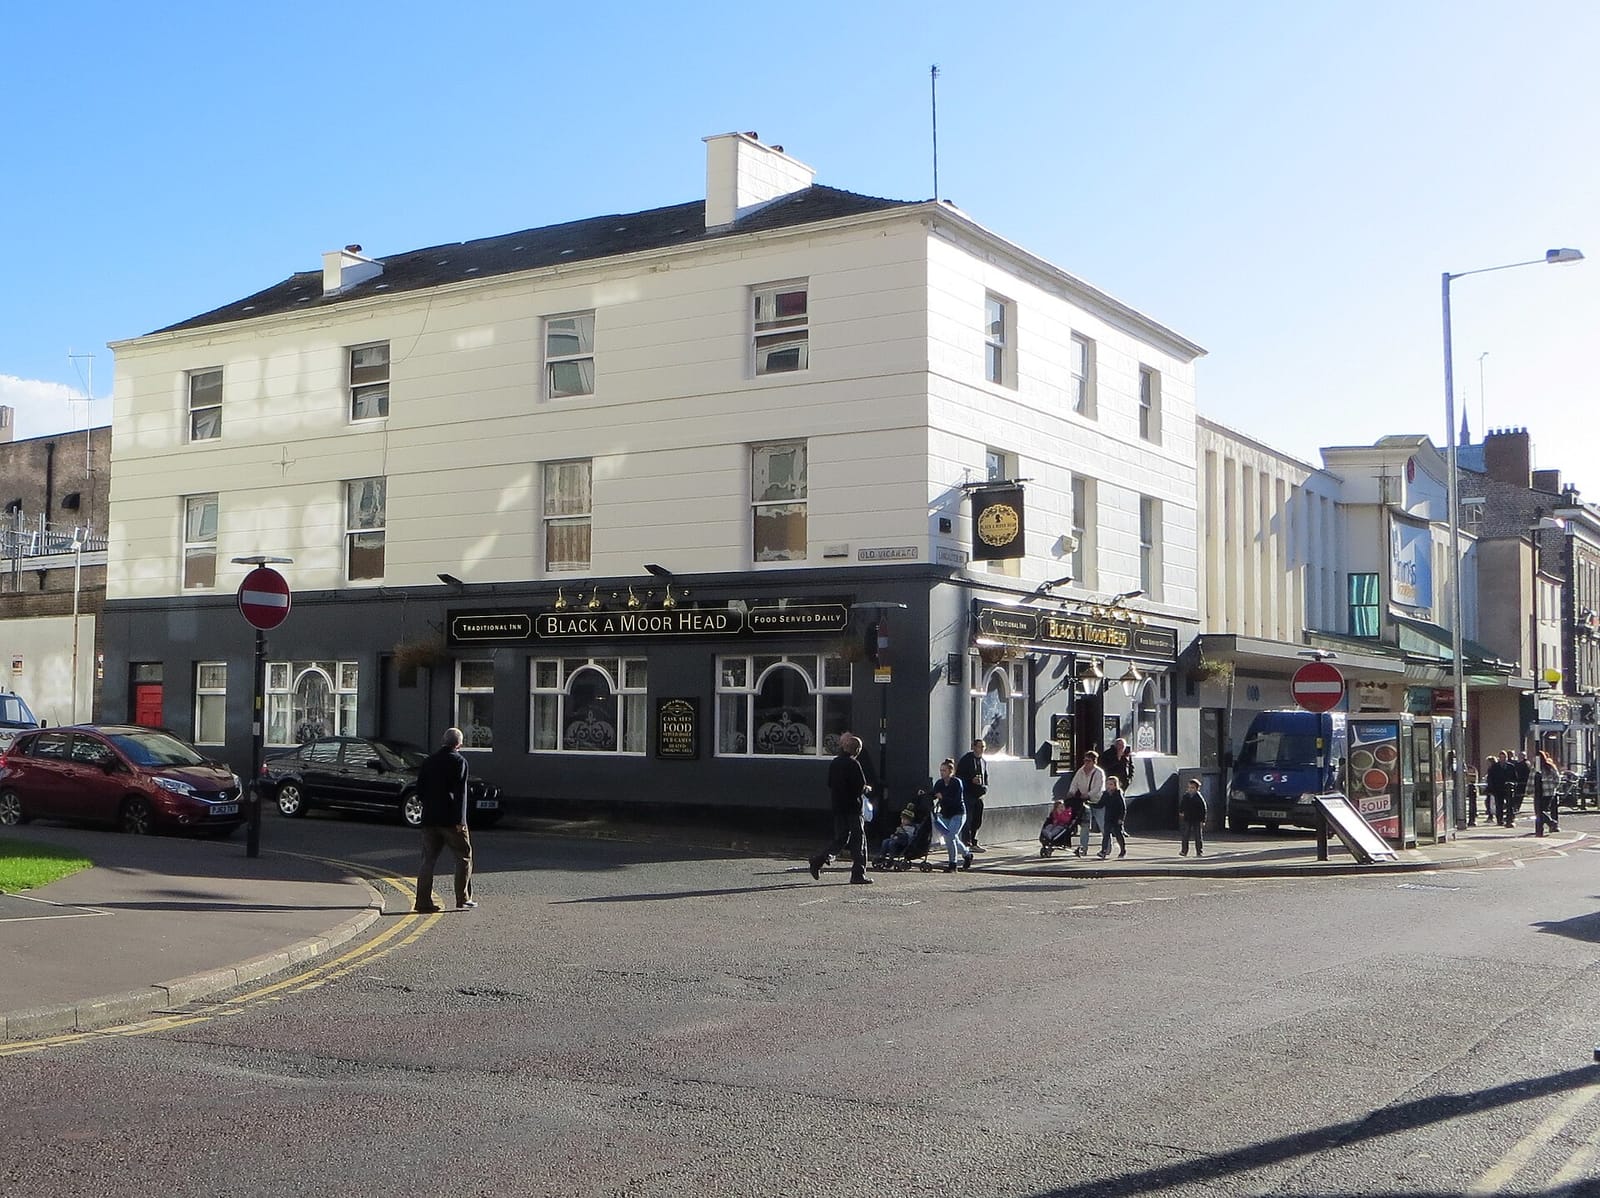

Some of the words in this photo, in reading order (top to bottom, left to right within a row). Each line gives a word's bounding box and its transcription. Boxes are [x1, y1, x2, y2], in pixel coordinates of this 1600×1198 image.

[860, 550, 876, 559] OLD
[547, 617, 598, 633] BLACK
[604, 618, 614, 632] A
[620, 614, 673, 632] MOOR
[679, 612, 727, 630] HEAD
[754, 616, 777, 624] FOOD
[780, 615, 812, 623] SERVED
[815, 614, 841, 622] DAILY
[463, 624, 508, 632] TRADITIONAL
[1049, 619, 1076, 640] BLACK
[1108, 627, 1127, 646] HEAD
[663, 722, 692, 732] FOOD
[1361, 799, 1389, 813] SOUP
